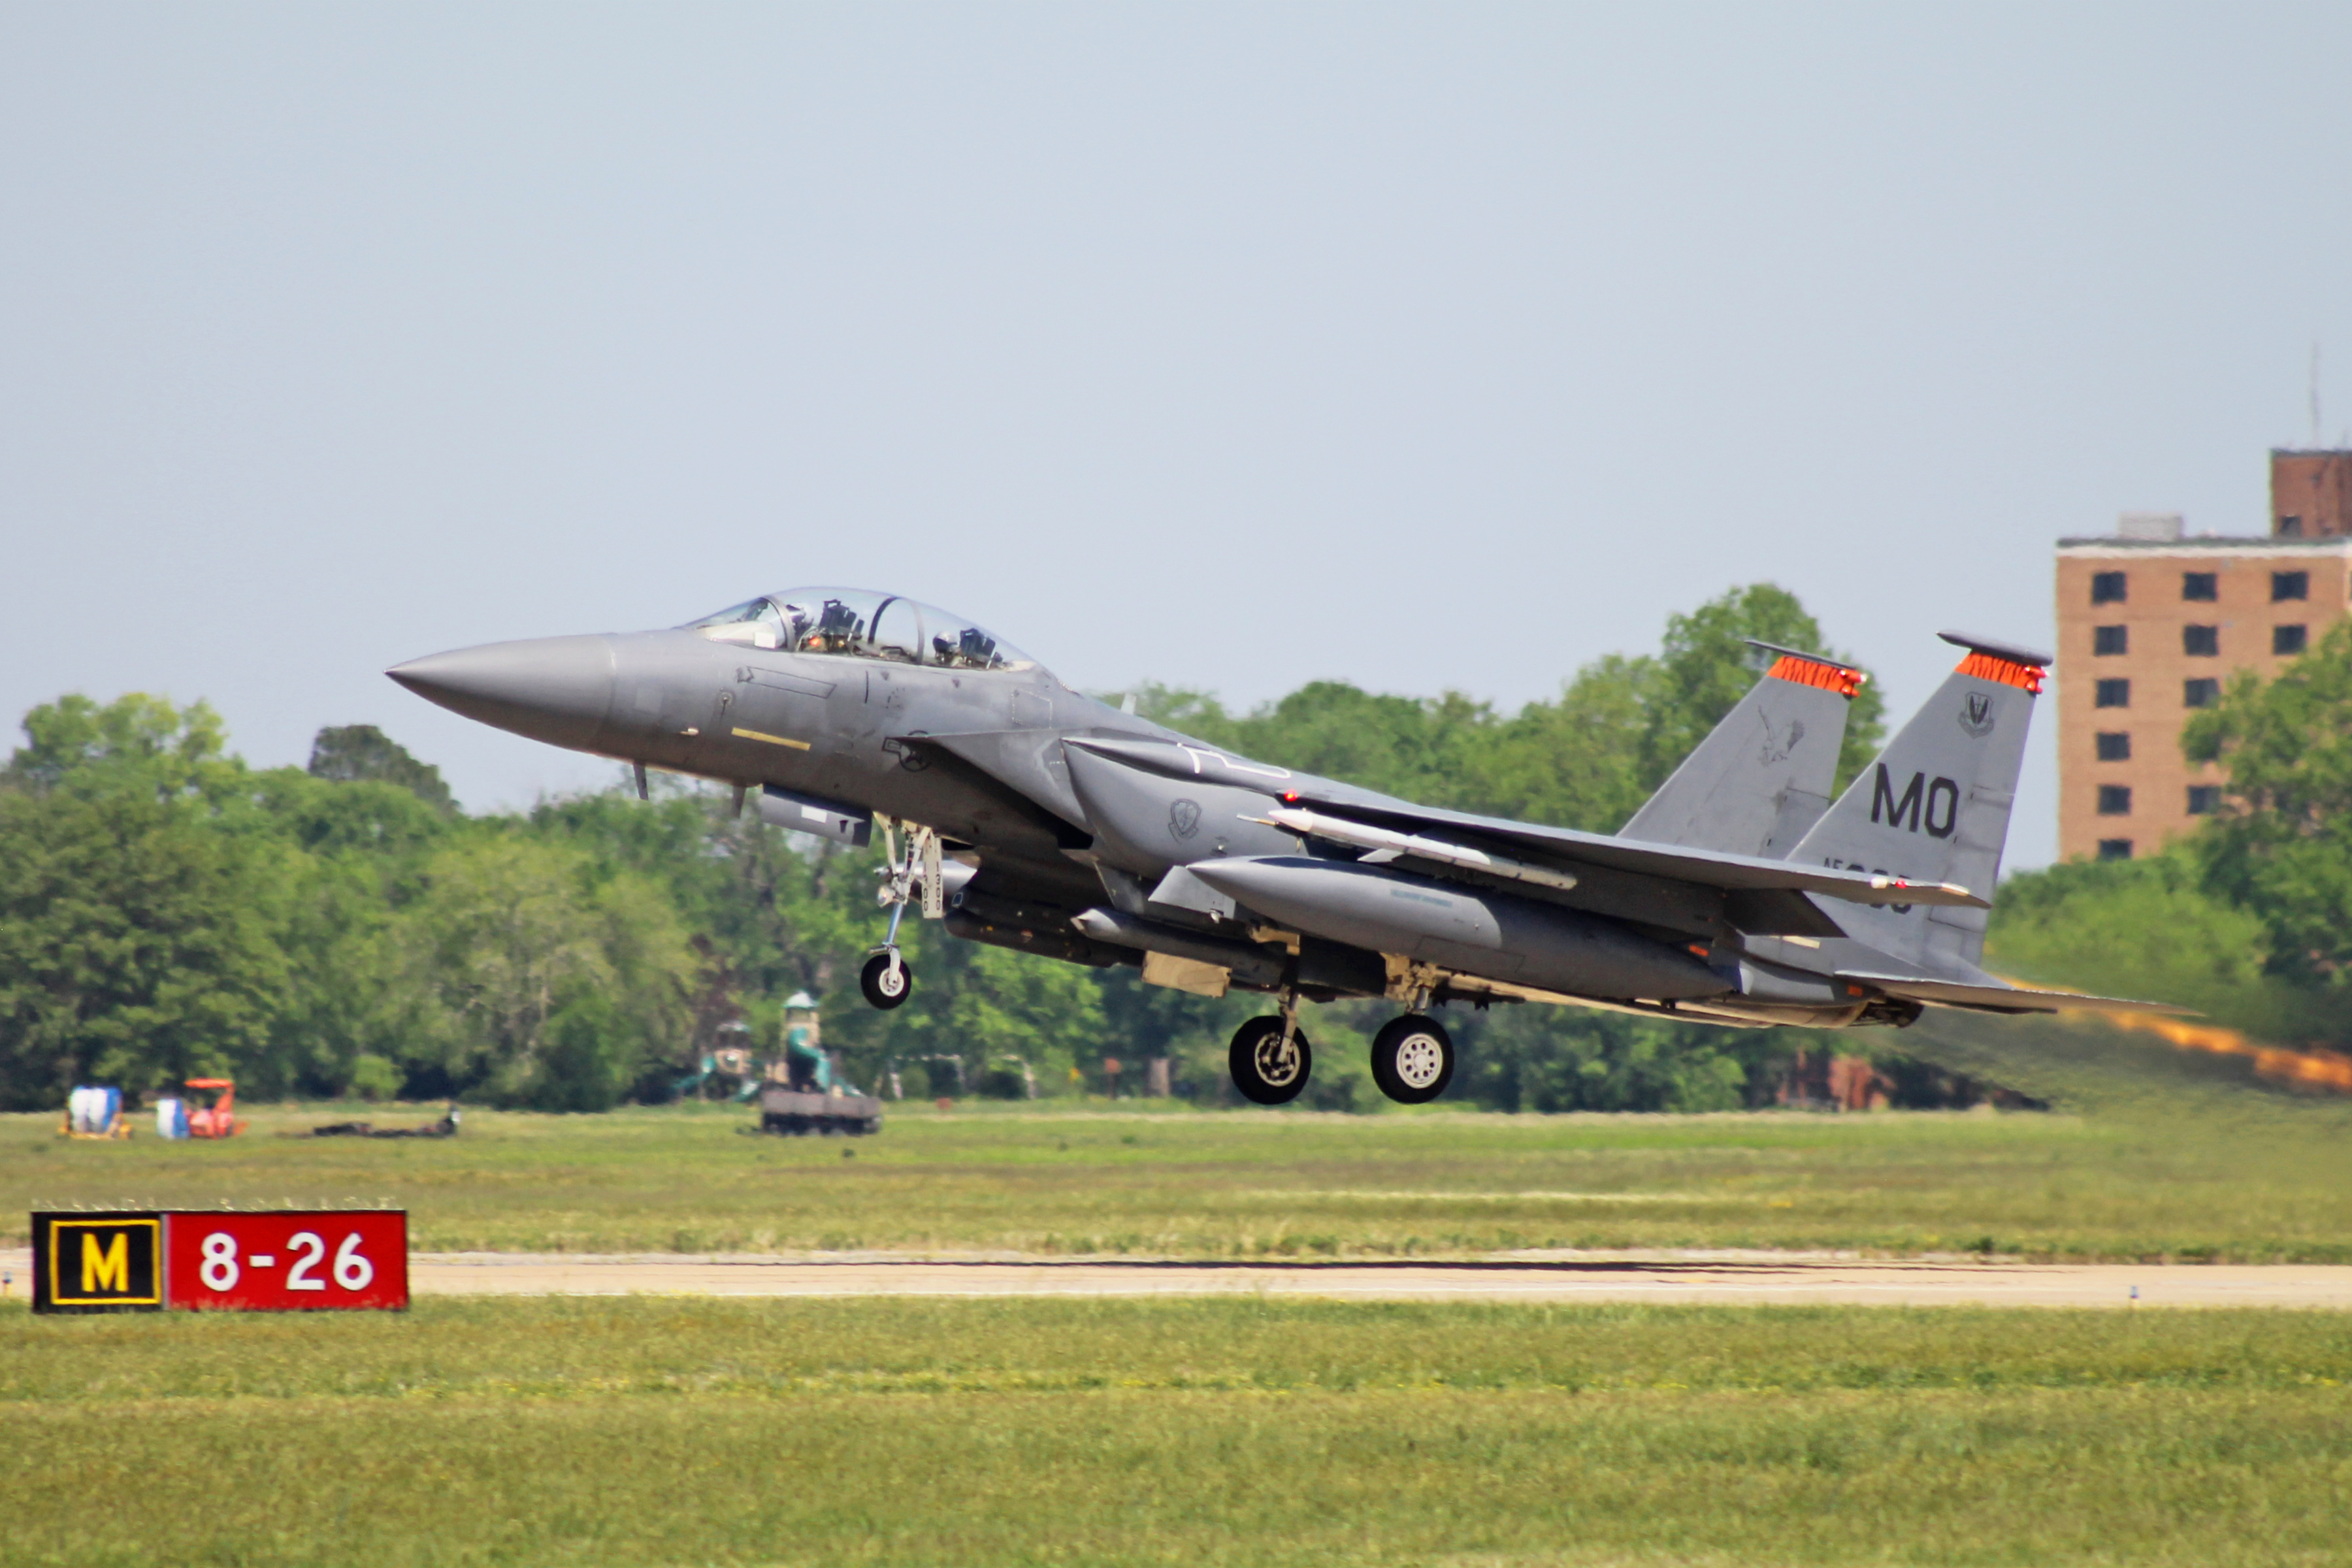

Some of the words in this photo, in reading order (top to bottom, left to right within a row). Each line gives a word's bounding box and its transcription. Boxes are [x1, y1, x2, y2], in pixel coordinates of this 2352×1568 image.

[1870, 762, 1959, 839] MO
[82, 1232, 128, 1292] M
[200, 1232, 373, 1291] 8-26
